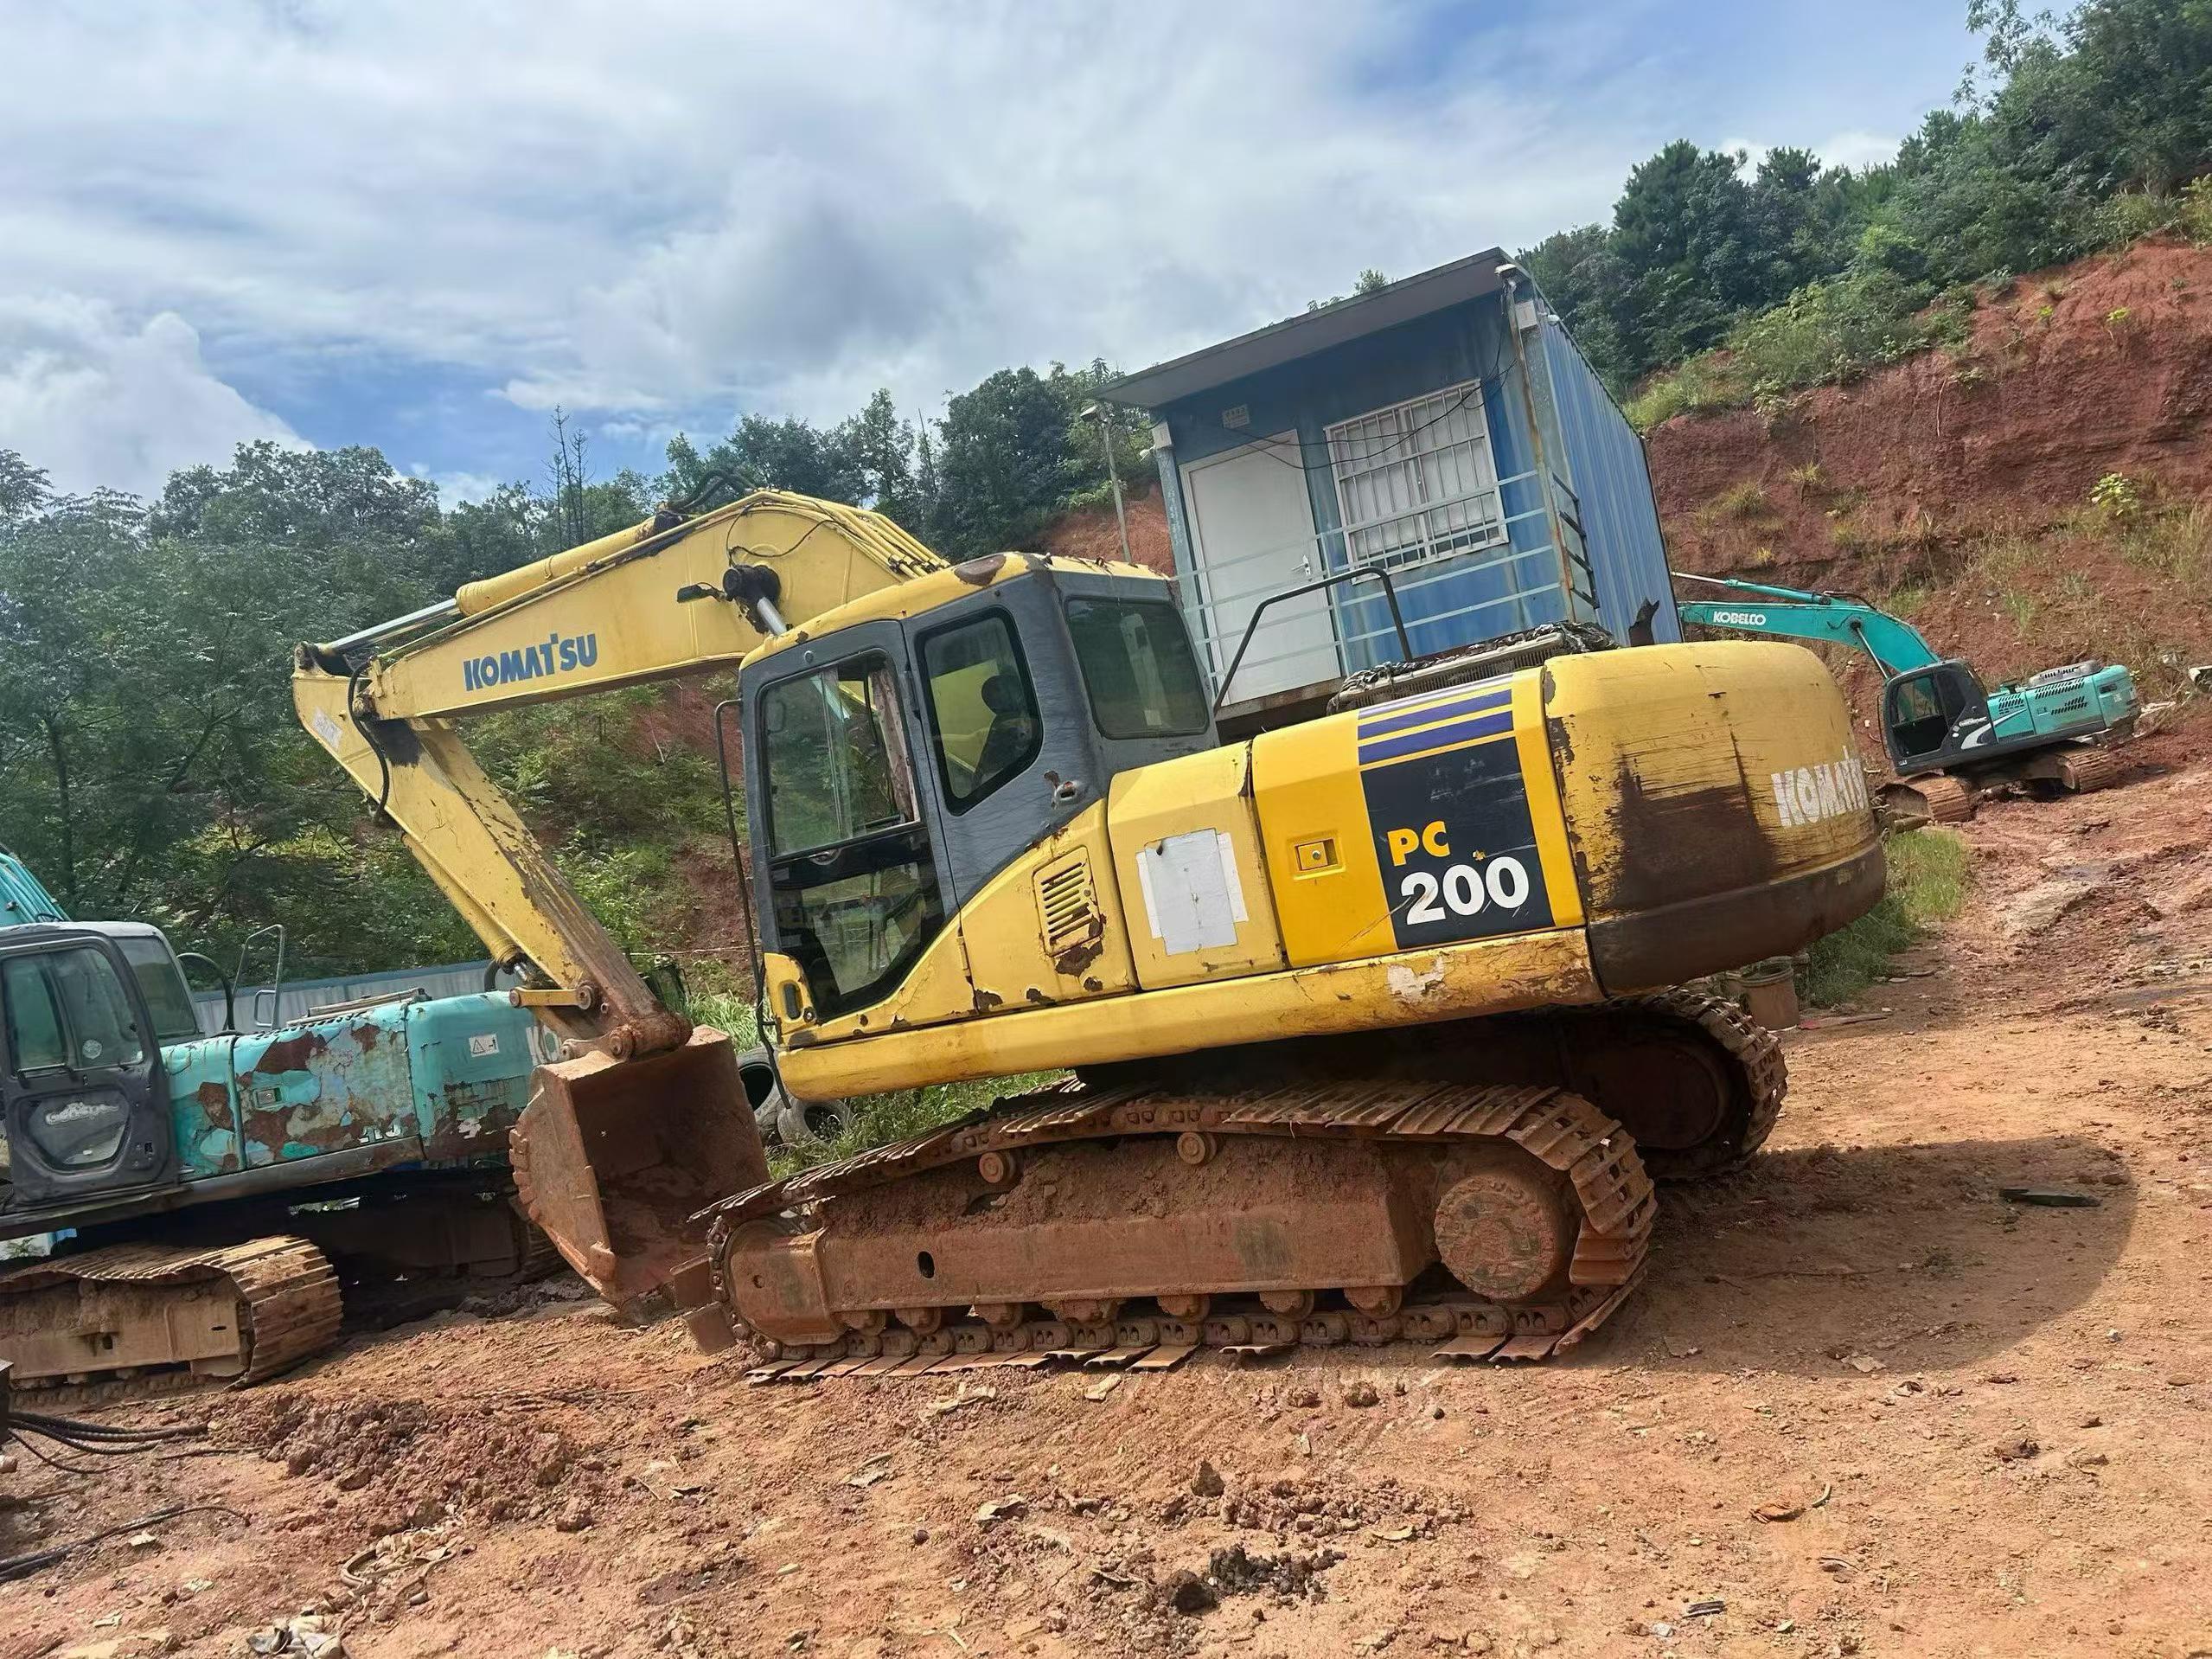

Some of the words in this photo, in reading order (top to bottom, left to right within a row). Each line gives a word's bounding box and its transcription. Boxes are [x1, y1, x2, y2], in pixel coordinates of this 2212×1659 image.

[1713, 611, 1767, 626] KOBELCO
[463, 632, 598, 692] KOMATSU
[1386, 821, 1451, 867] PC
[1400, 856, 1530, 926] 200
